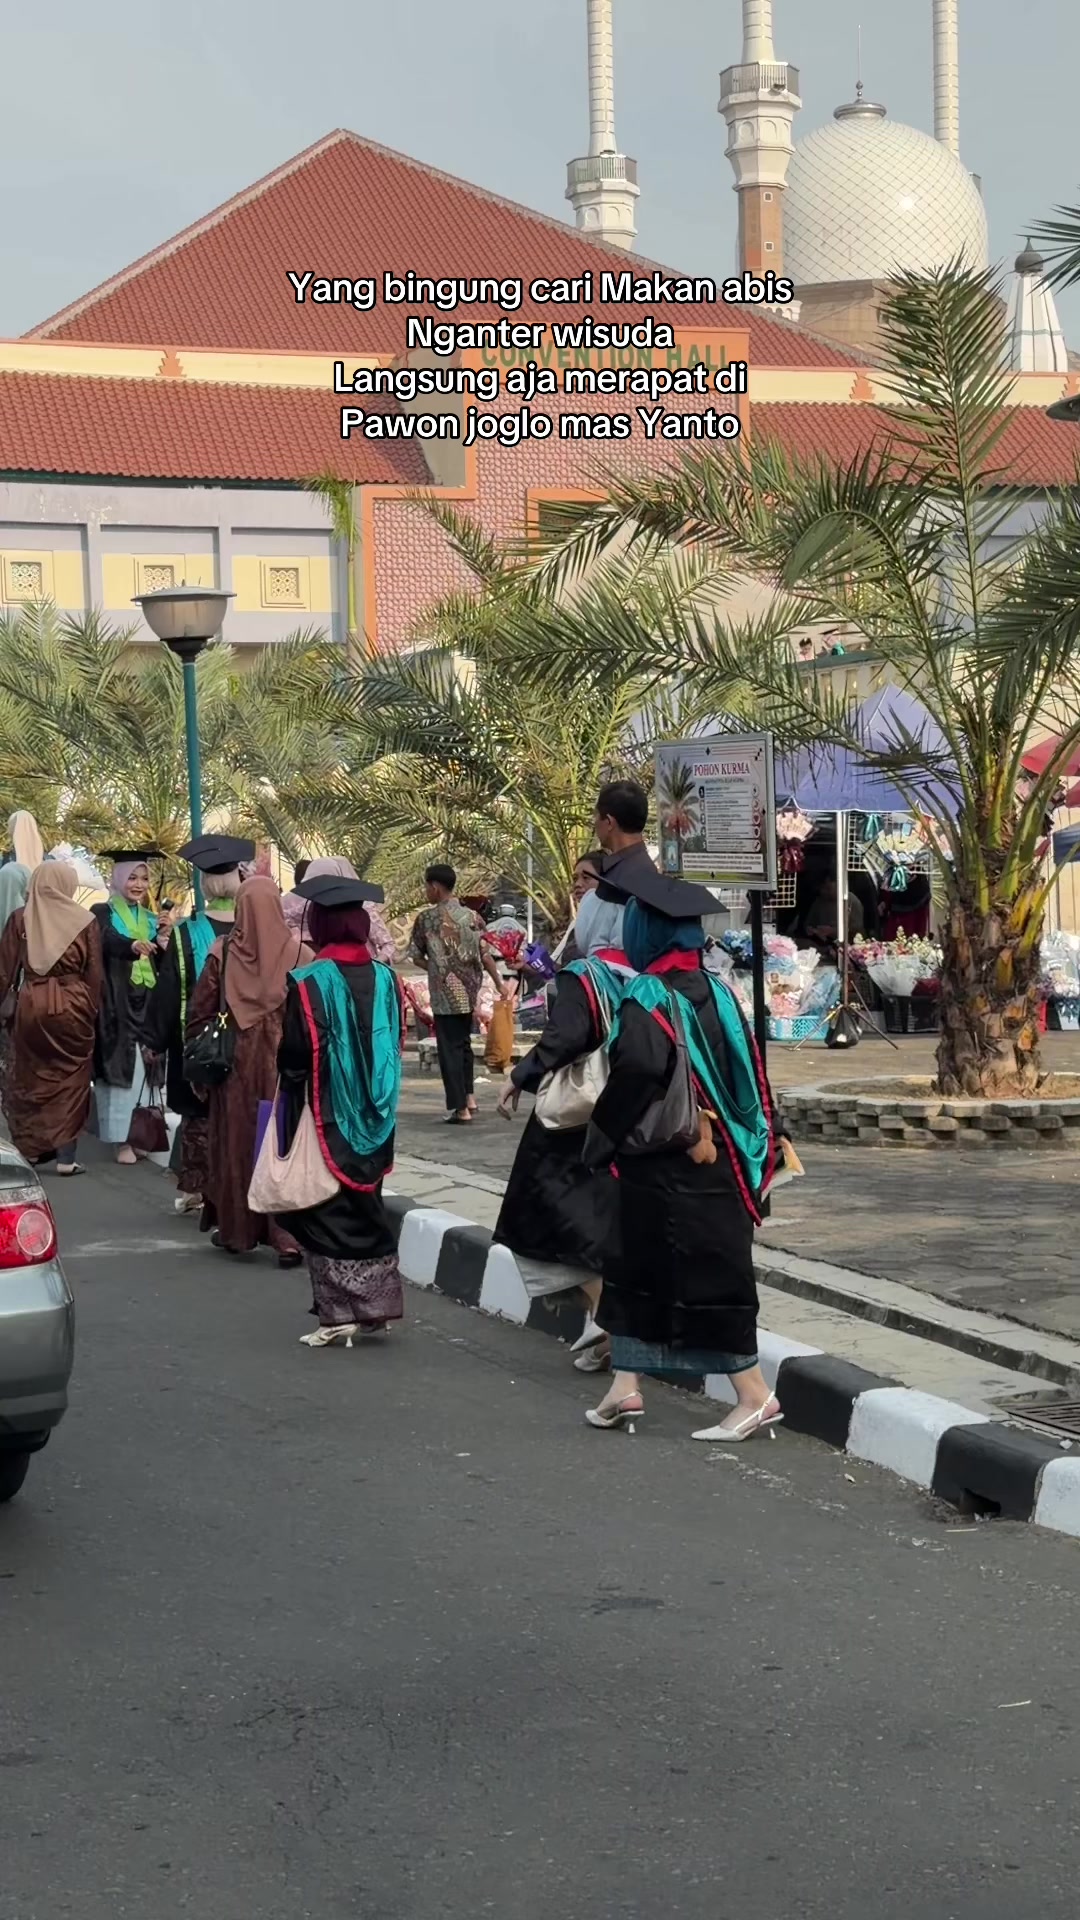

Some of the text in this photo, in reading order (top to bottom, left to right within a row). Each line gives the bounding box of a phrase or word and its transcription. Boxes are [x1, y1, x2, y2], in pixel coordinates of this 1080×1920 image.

[481, 340, 730, 372] CONVENTION HALL
[694, 762, 750, 776] POHON KURMA
